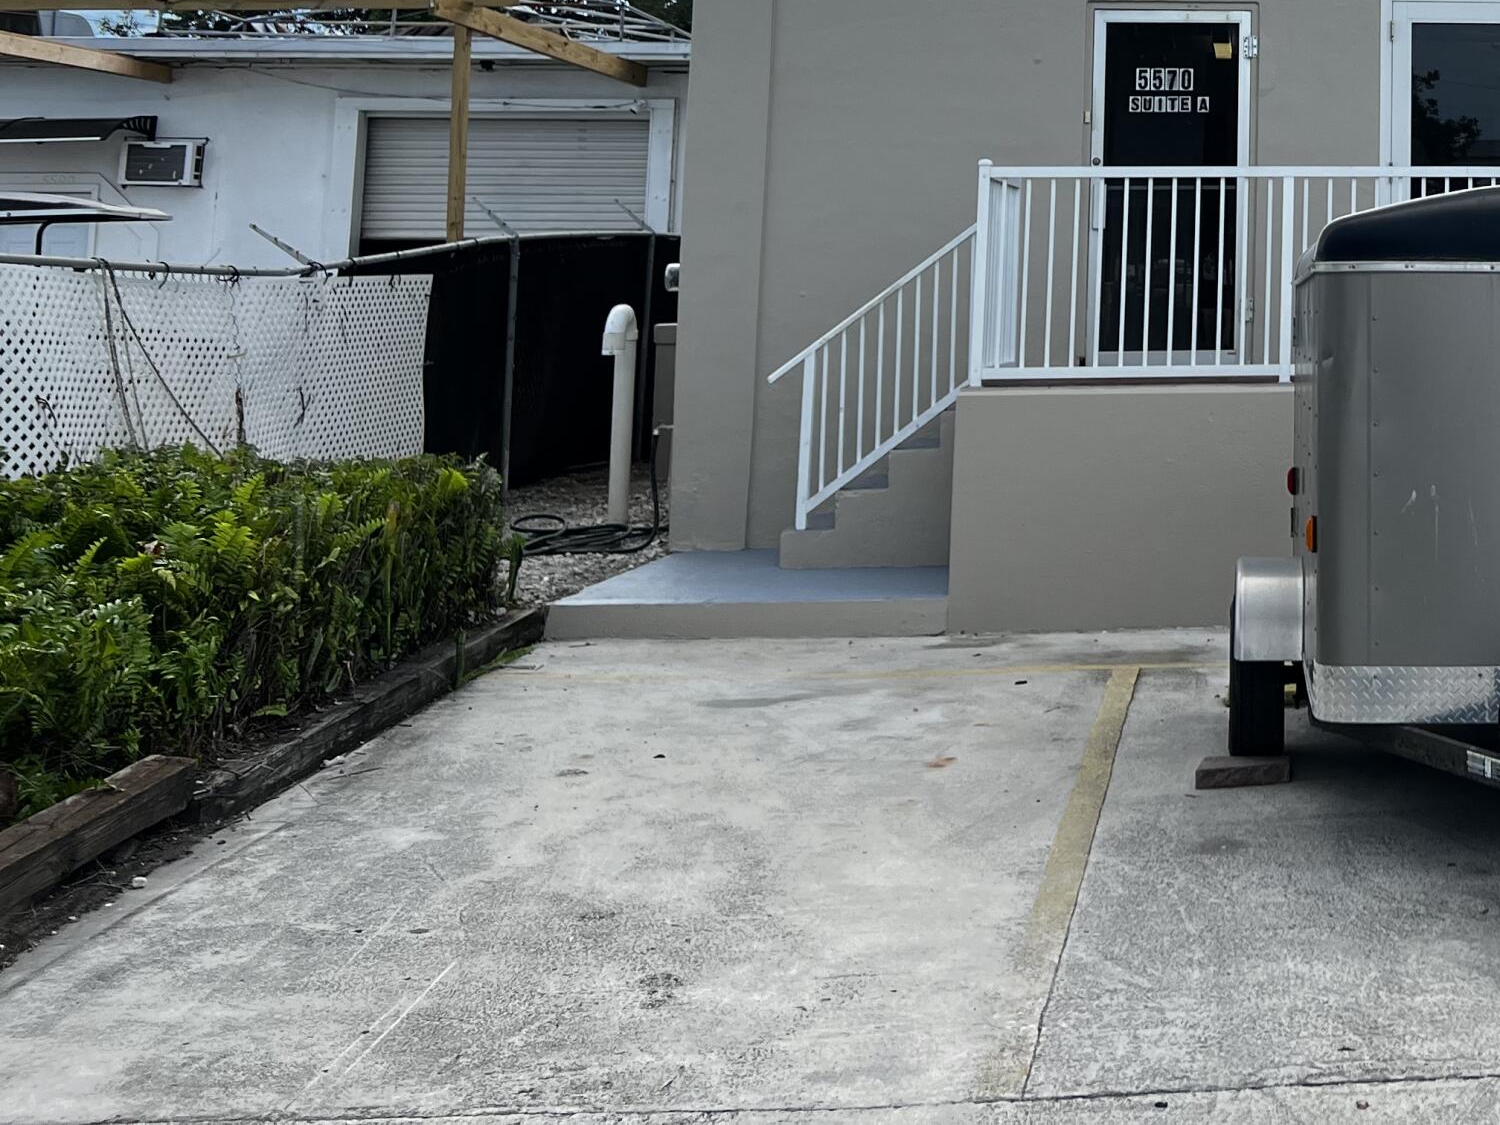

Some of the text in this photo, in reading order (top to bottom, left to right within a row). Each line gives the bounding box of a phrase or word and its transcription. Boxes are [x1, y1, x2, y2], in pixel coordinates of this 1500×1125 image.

[1136, 68, 1193, 90] 5570
[1129, 96, 1209, 112] SUITE A
